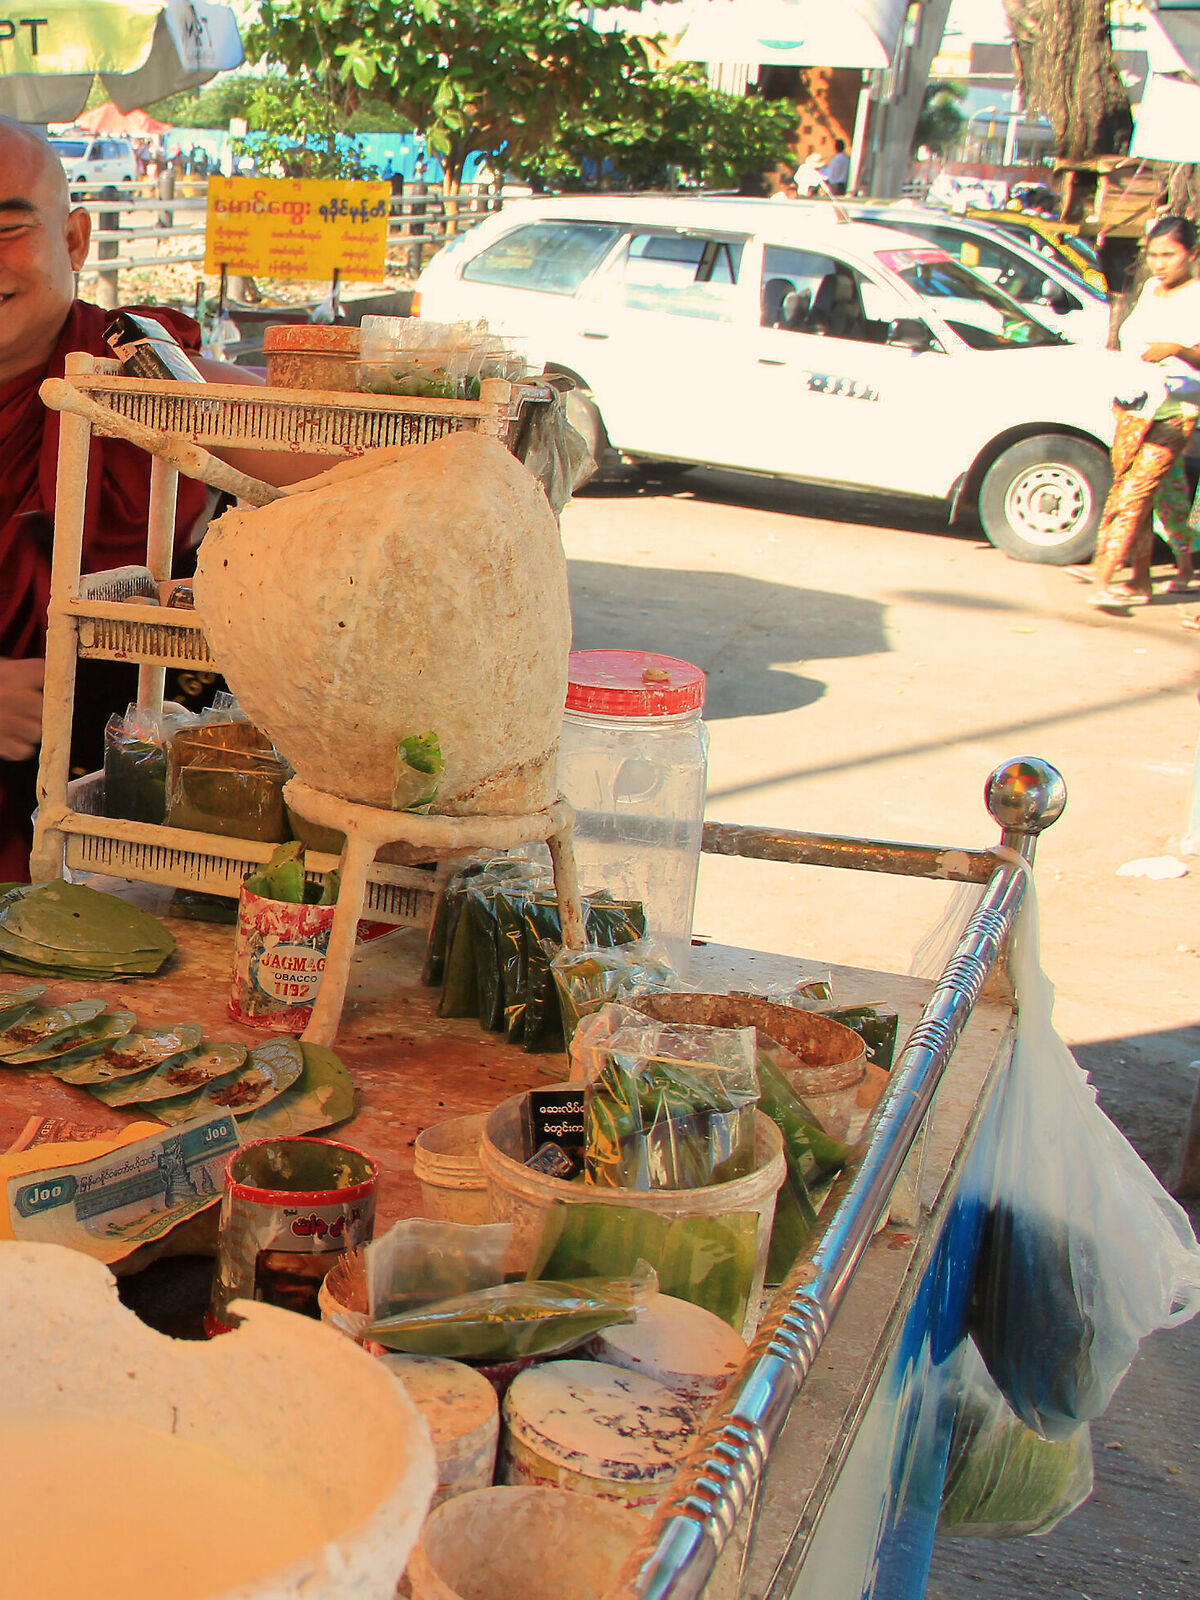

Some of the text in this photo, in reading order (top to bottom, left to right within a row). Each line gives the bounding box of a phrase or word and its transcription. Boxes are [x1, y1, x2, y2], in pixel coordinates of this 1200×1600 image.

[261, 952, 327, 972] JAGMAG
[272, 971, 318, 983] OBACCO
[40, 1119, 56, 1136] RED
